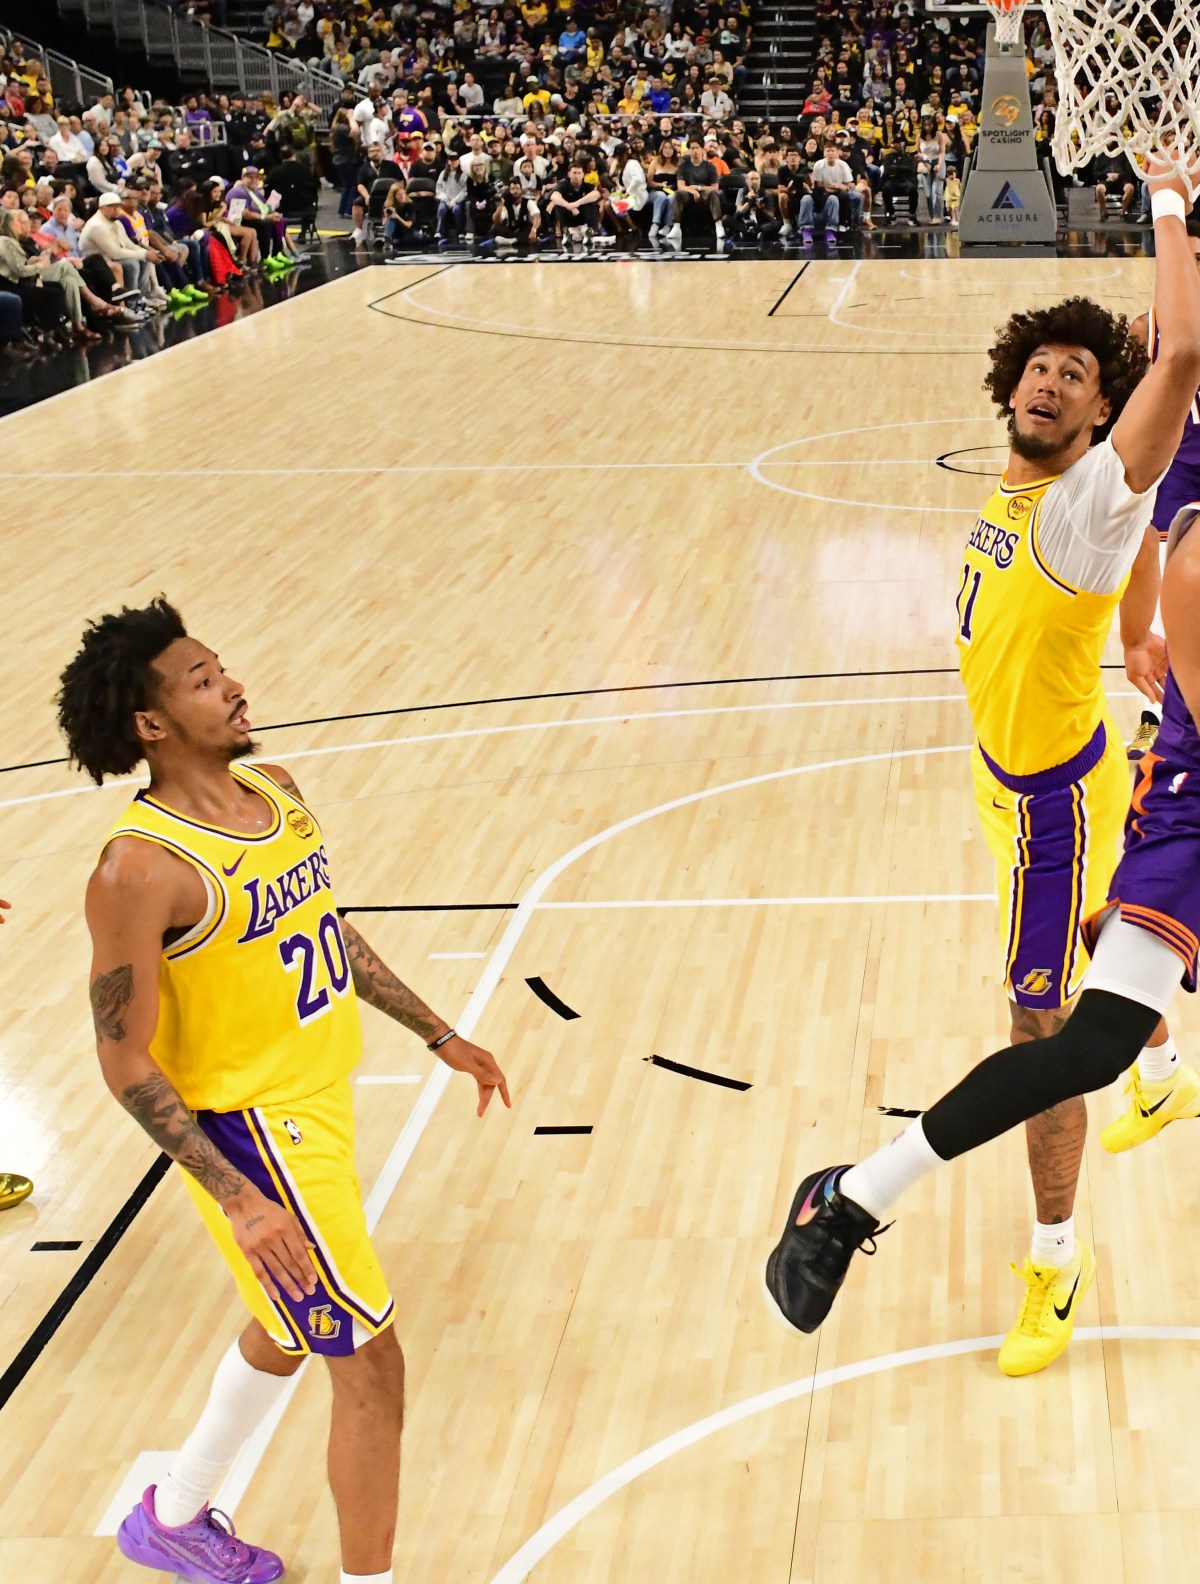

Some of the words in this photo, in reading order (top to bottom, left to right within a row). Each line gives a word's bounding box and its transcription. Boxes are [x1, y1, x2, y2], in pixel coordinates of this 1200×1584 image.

[978, 213, 1039, 223] ACRISURE
[965, 518, 1020, 569] AKERS
[236, 844, 332, 945] LAKERS
[278, 911, 350, 1023] 20
